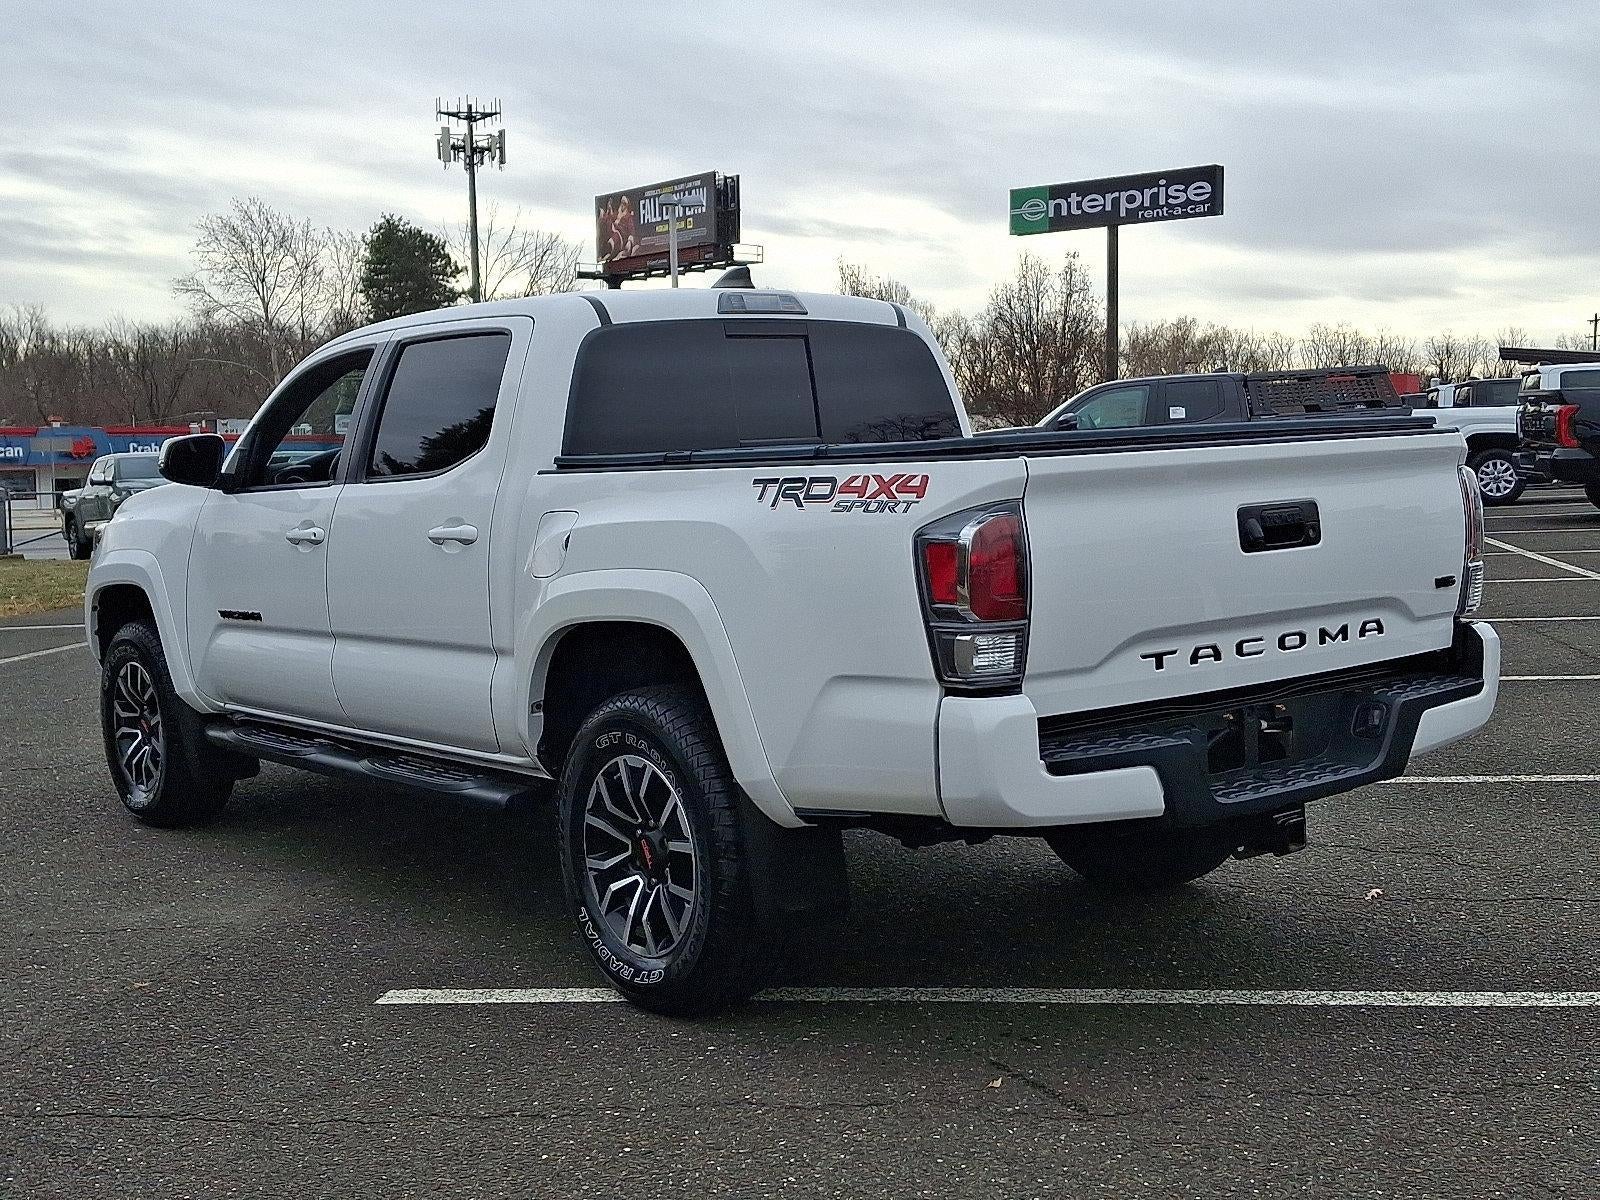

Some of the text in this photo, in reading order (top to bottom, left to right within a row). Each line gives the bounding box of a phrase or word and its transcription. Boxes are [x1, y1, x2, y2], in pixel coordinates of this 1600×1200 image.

[640, 196, 662, 225] FALL
[1011, 178, 1212, 222] enterprise
[1138, 203, 1211, 219] rent-a-car
[752, 473, 930, 511] TRD 4X4
[830, 499, 920, 514] SPORT
[1139, 616, 1385, 671] TACOMA
[596, 731, 622, 749] GT
[578, 906, 665, 984] GT RADIAL
